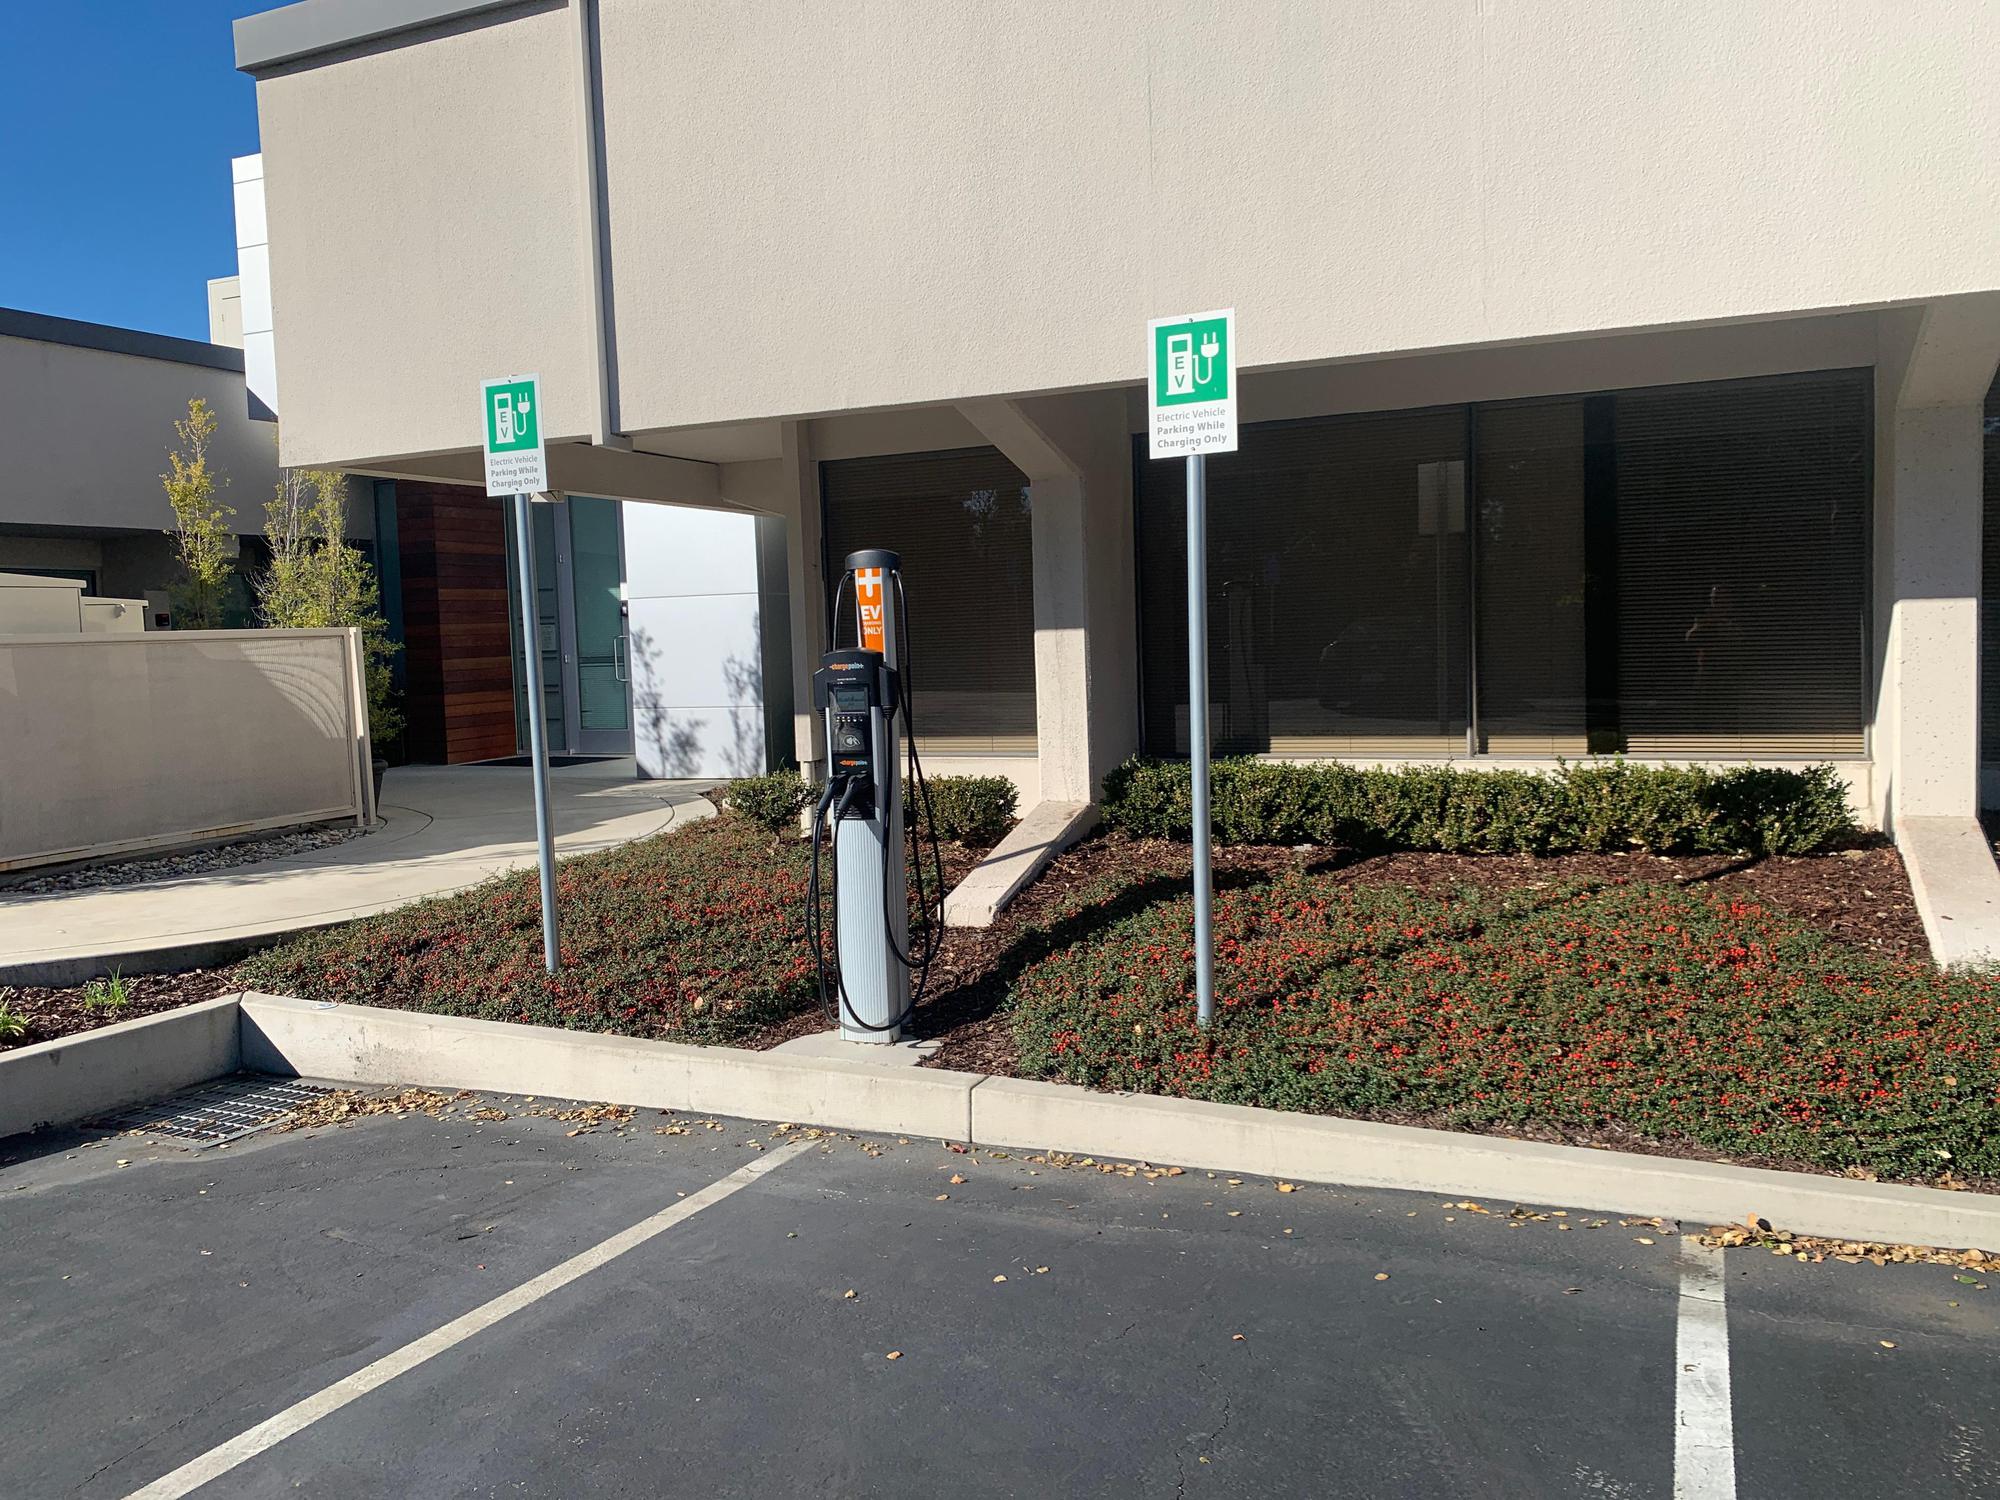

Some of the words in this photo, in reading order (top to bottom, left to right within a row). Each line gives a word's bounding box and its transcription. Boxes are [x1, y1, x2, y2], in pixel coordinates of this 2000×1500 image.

[1174, 356, 1185, 388] EV
[1157, 410, 1190, 422] Electric
[1192, 407, 1226, 418] Vehicle
[1157, 424, 1195, 435] Parking
[1197, 420, 1225, 431] While
[1157, 437, 1202, 448] Charging
[1204, 434, 1227, 445] Only
[490, 457, 513, 466] Electric
[515, 455, 538, 464] Vehicle
[491, 467, 517, 477] Parking
[518, 466, 538, 475] While
[492, 478, 522, 488] Charging
[523, 476, 540, 486] Only
[860, 605, 881, 620] EV
[862, 626, 882, 635] ONLY
